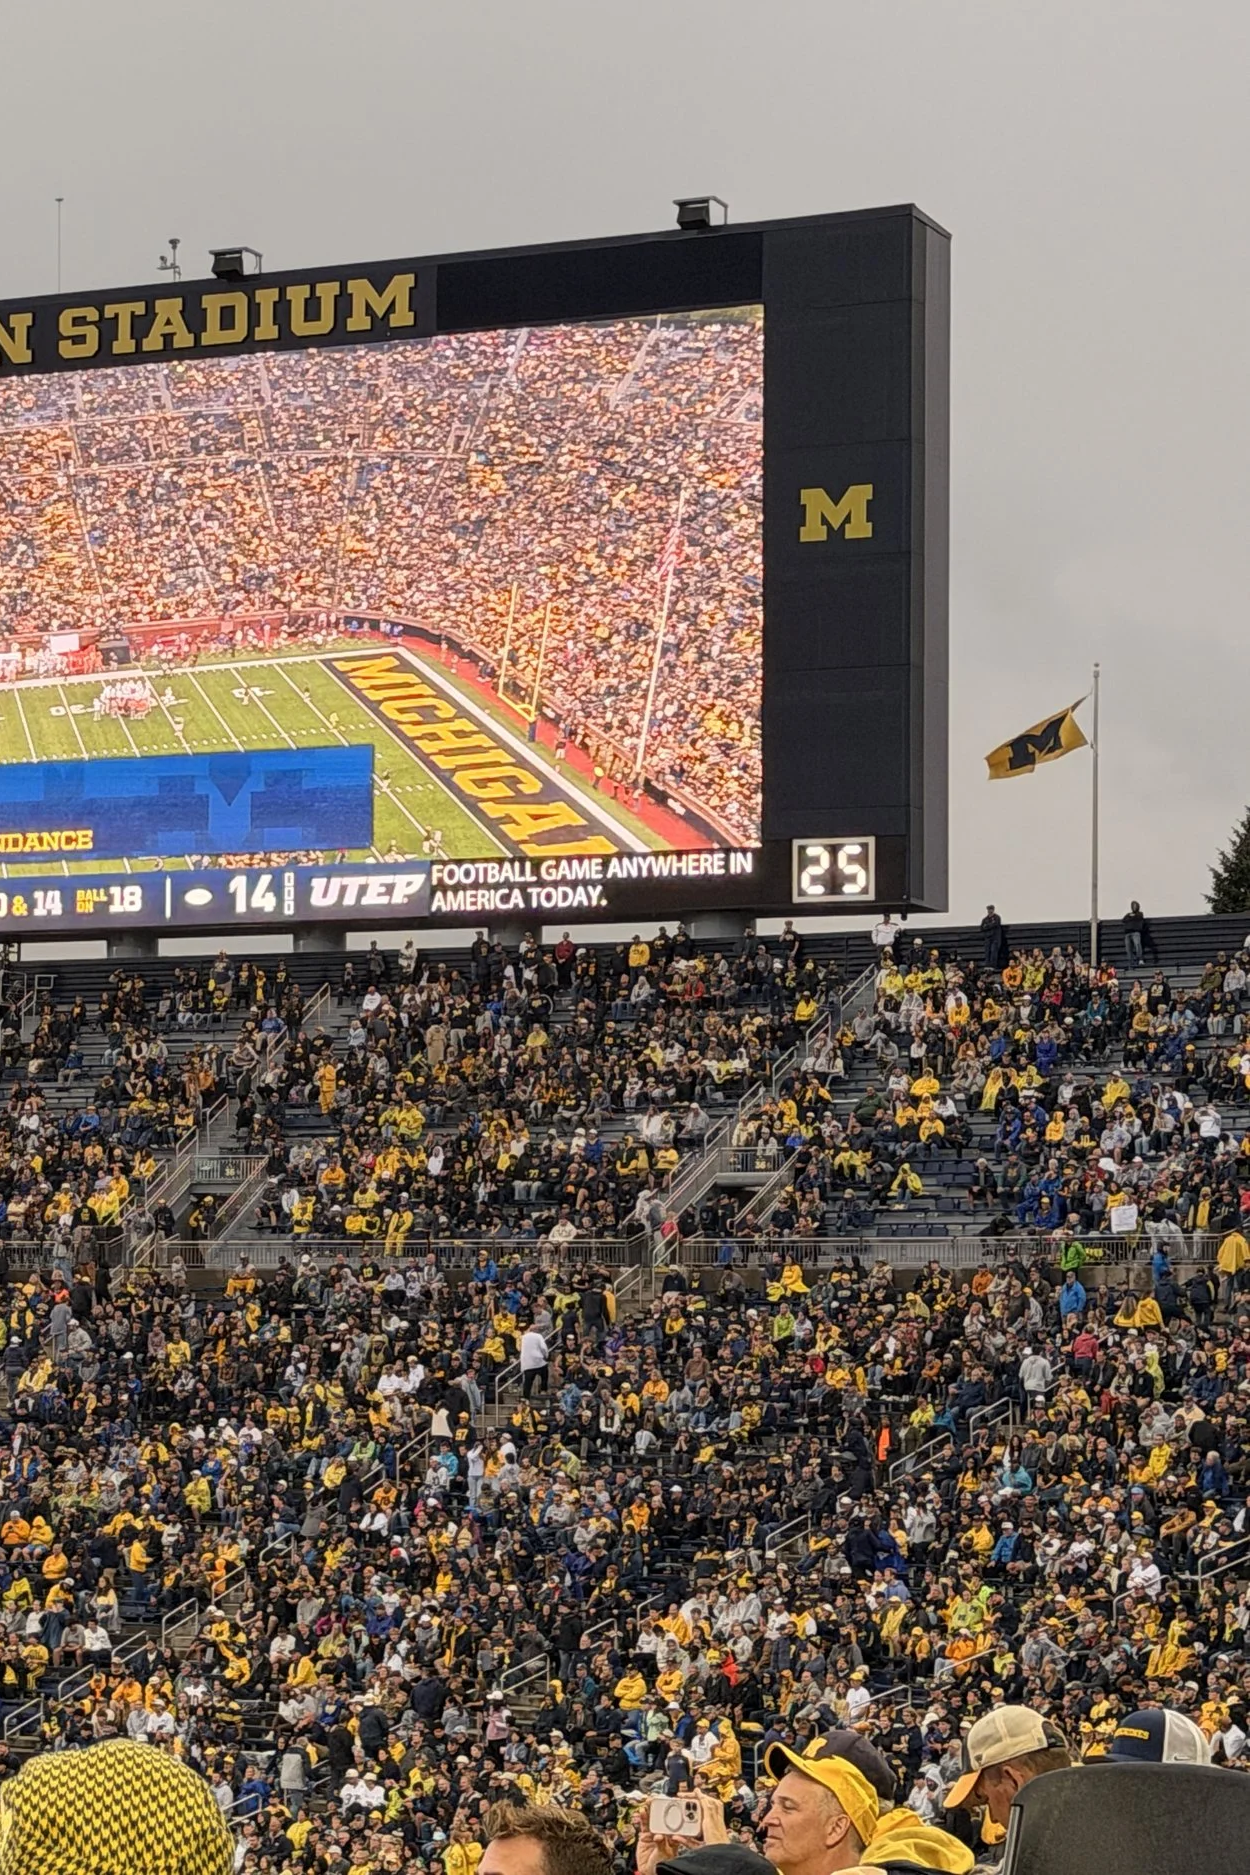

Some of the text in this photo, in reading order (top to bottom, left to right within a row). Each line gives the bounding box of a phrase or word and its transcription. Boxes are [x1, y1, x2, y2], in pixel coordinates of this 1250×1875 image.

[58, 273, 416, 359] STADIUM
[800, 484, 873, 542] M
[431, 853, 753, 886] FOOTBALL GAME ANYWHERE IN
[801, 844, 866, 894] 25
[12, 896, 28, 916] &
[33, 890, 63, 916] 14
[76, 889, 108, 903] BALL
[76, 886, 142, 914] ON 18
[228, 874, 277, 914] 14
[309, 873, 426, 907] UTEP
[431, 885, 607, 912] AMERICA TODAY.
